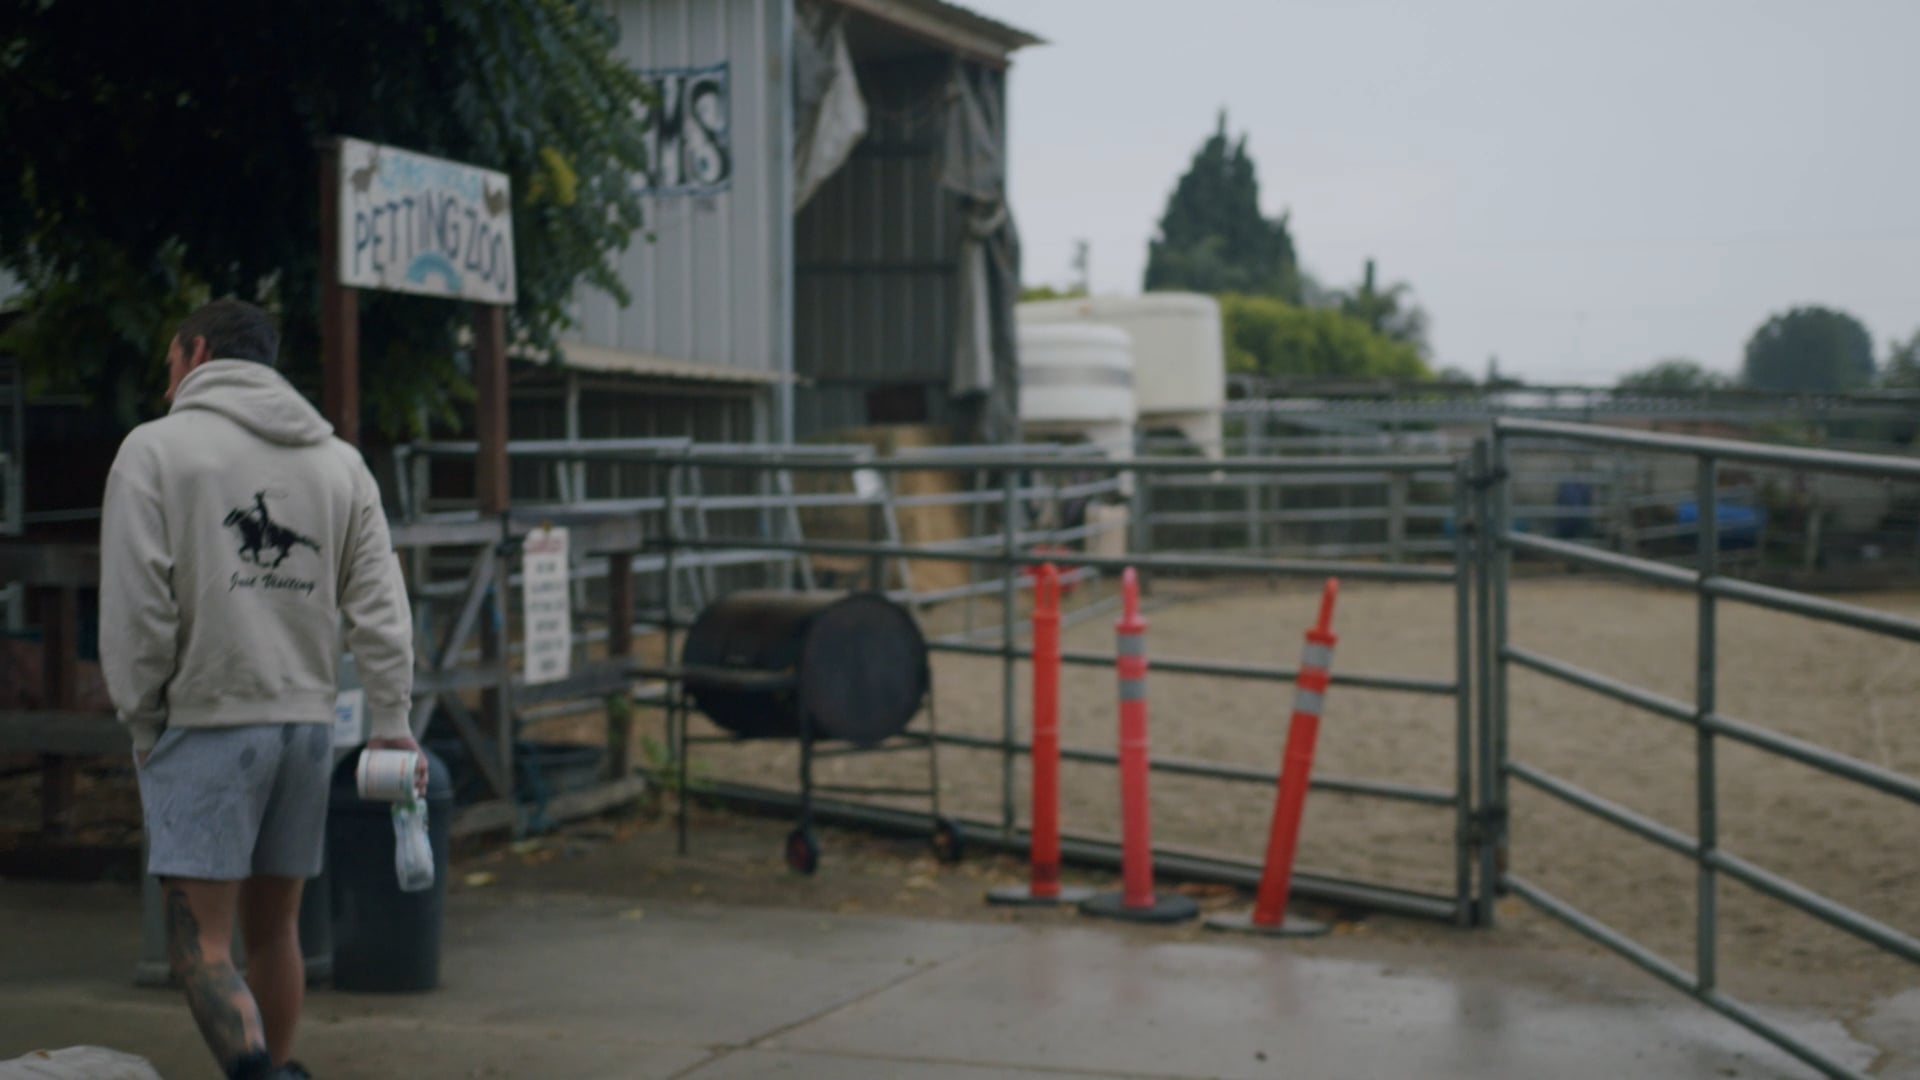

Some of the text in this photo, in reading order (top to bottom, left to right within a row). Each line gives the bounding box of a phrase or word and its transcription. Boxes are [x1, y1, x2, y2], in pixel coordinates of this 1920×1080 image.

[355, 188, 507, 295] PETTING ZOO
[228, 571, 316, 597] Just Visiting
